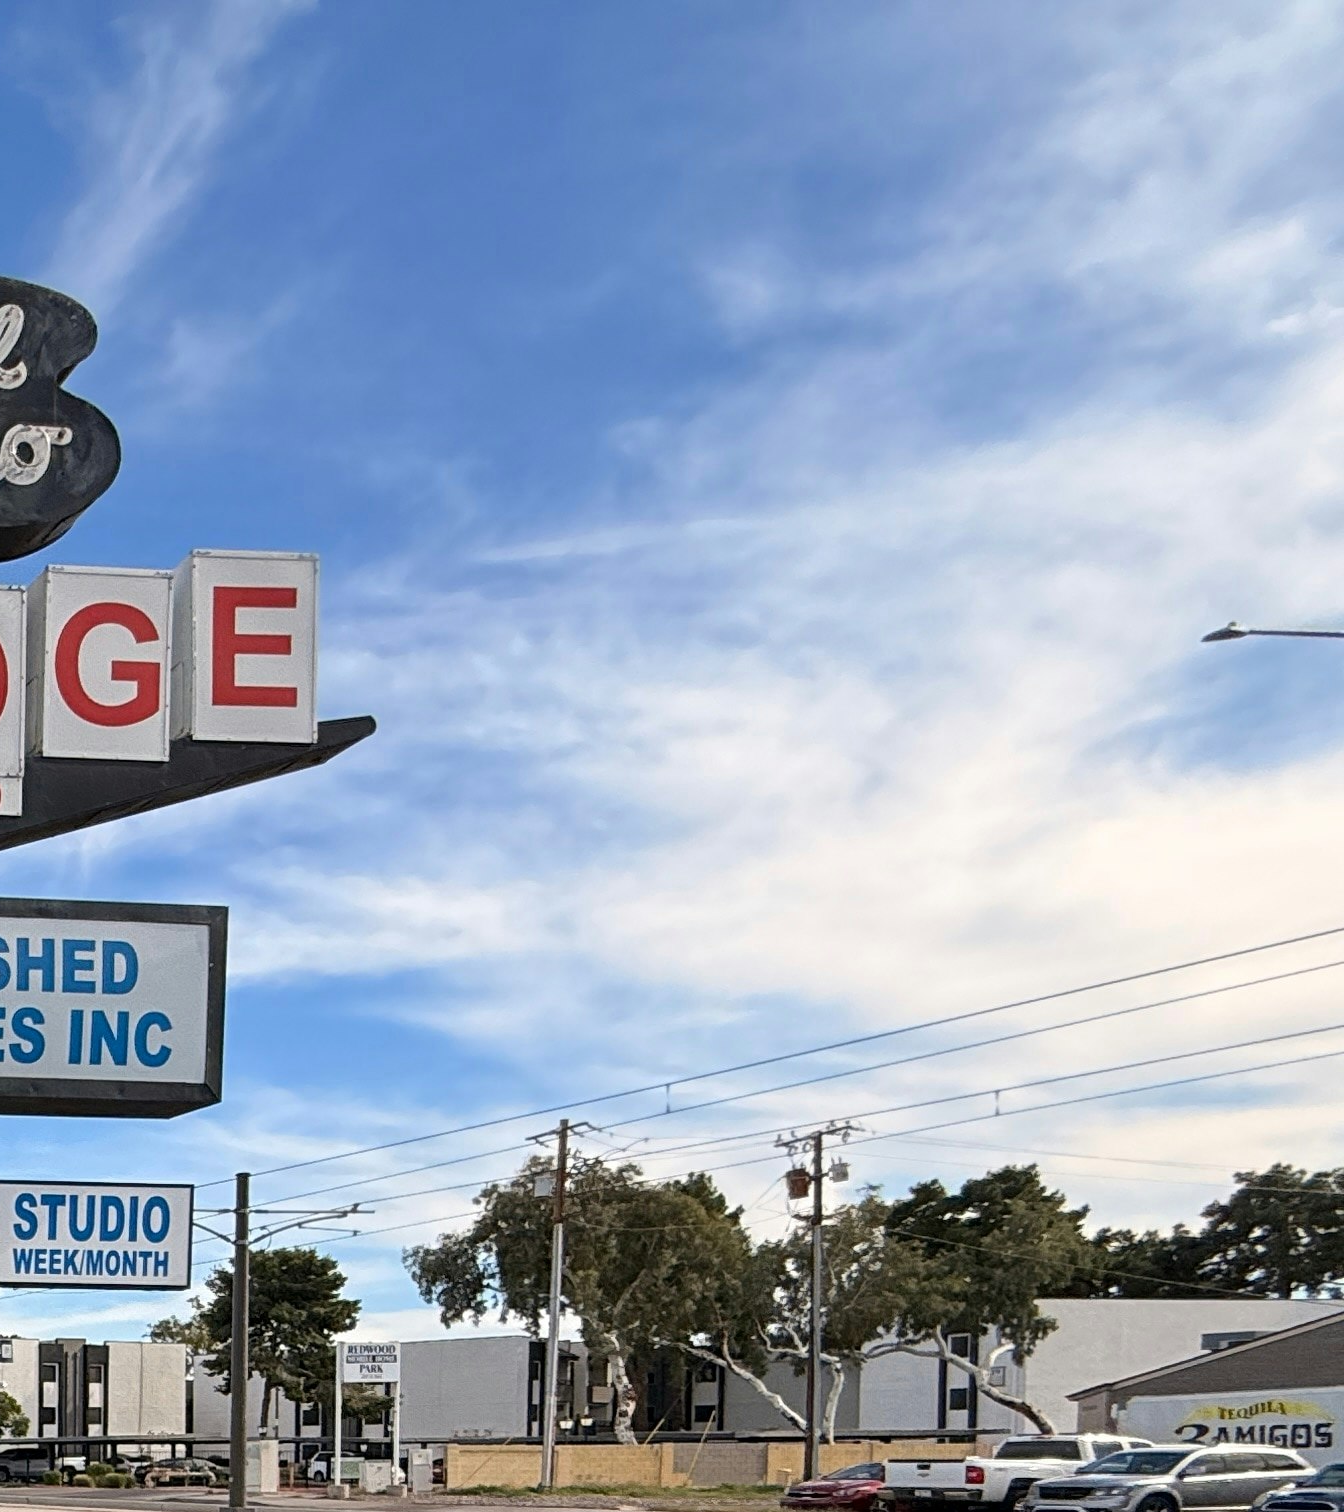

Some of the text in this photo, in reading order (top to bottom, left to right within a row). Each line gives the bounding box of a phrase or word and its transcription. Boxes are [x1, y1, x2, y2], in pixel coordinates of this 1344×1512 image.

[68, 1009, 172, 1067] INC
[13, 1193, 170, 1243] STUDIO
[13, 1249, 169, 1277] WEEK/MONTH
[347, 1345, 396, 1354] REDWOOD
[359, 1364, 383, 1374] PARK
[1217, 1401, 1288, 1420] TEQUILA
[1212, 1422, 1334, 1448] AMIGOS
